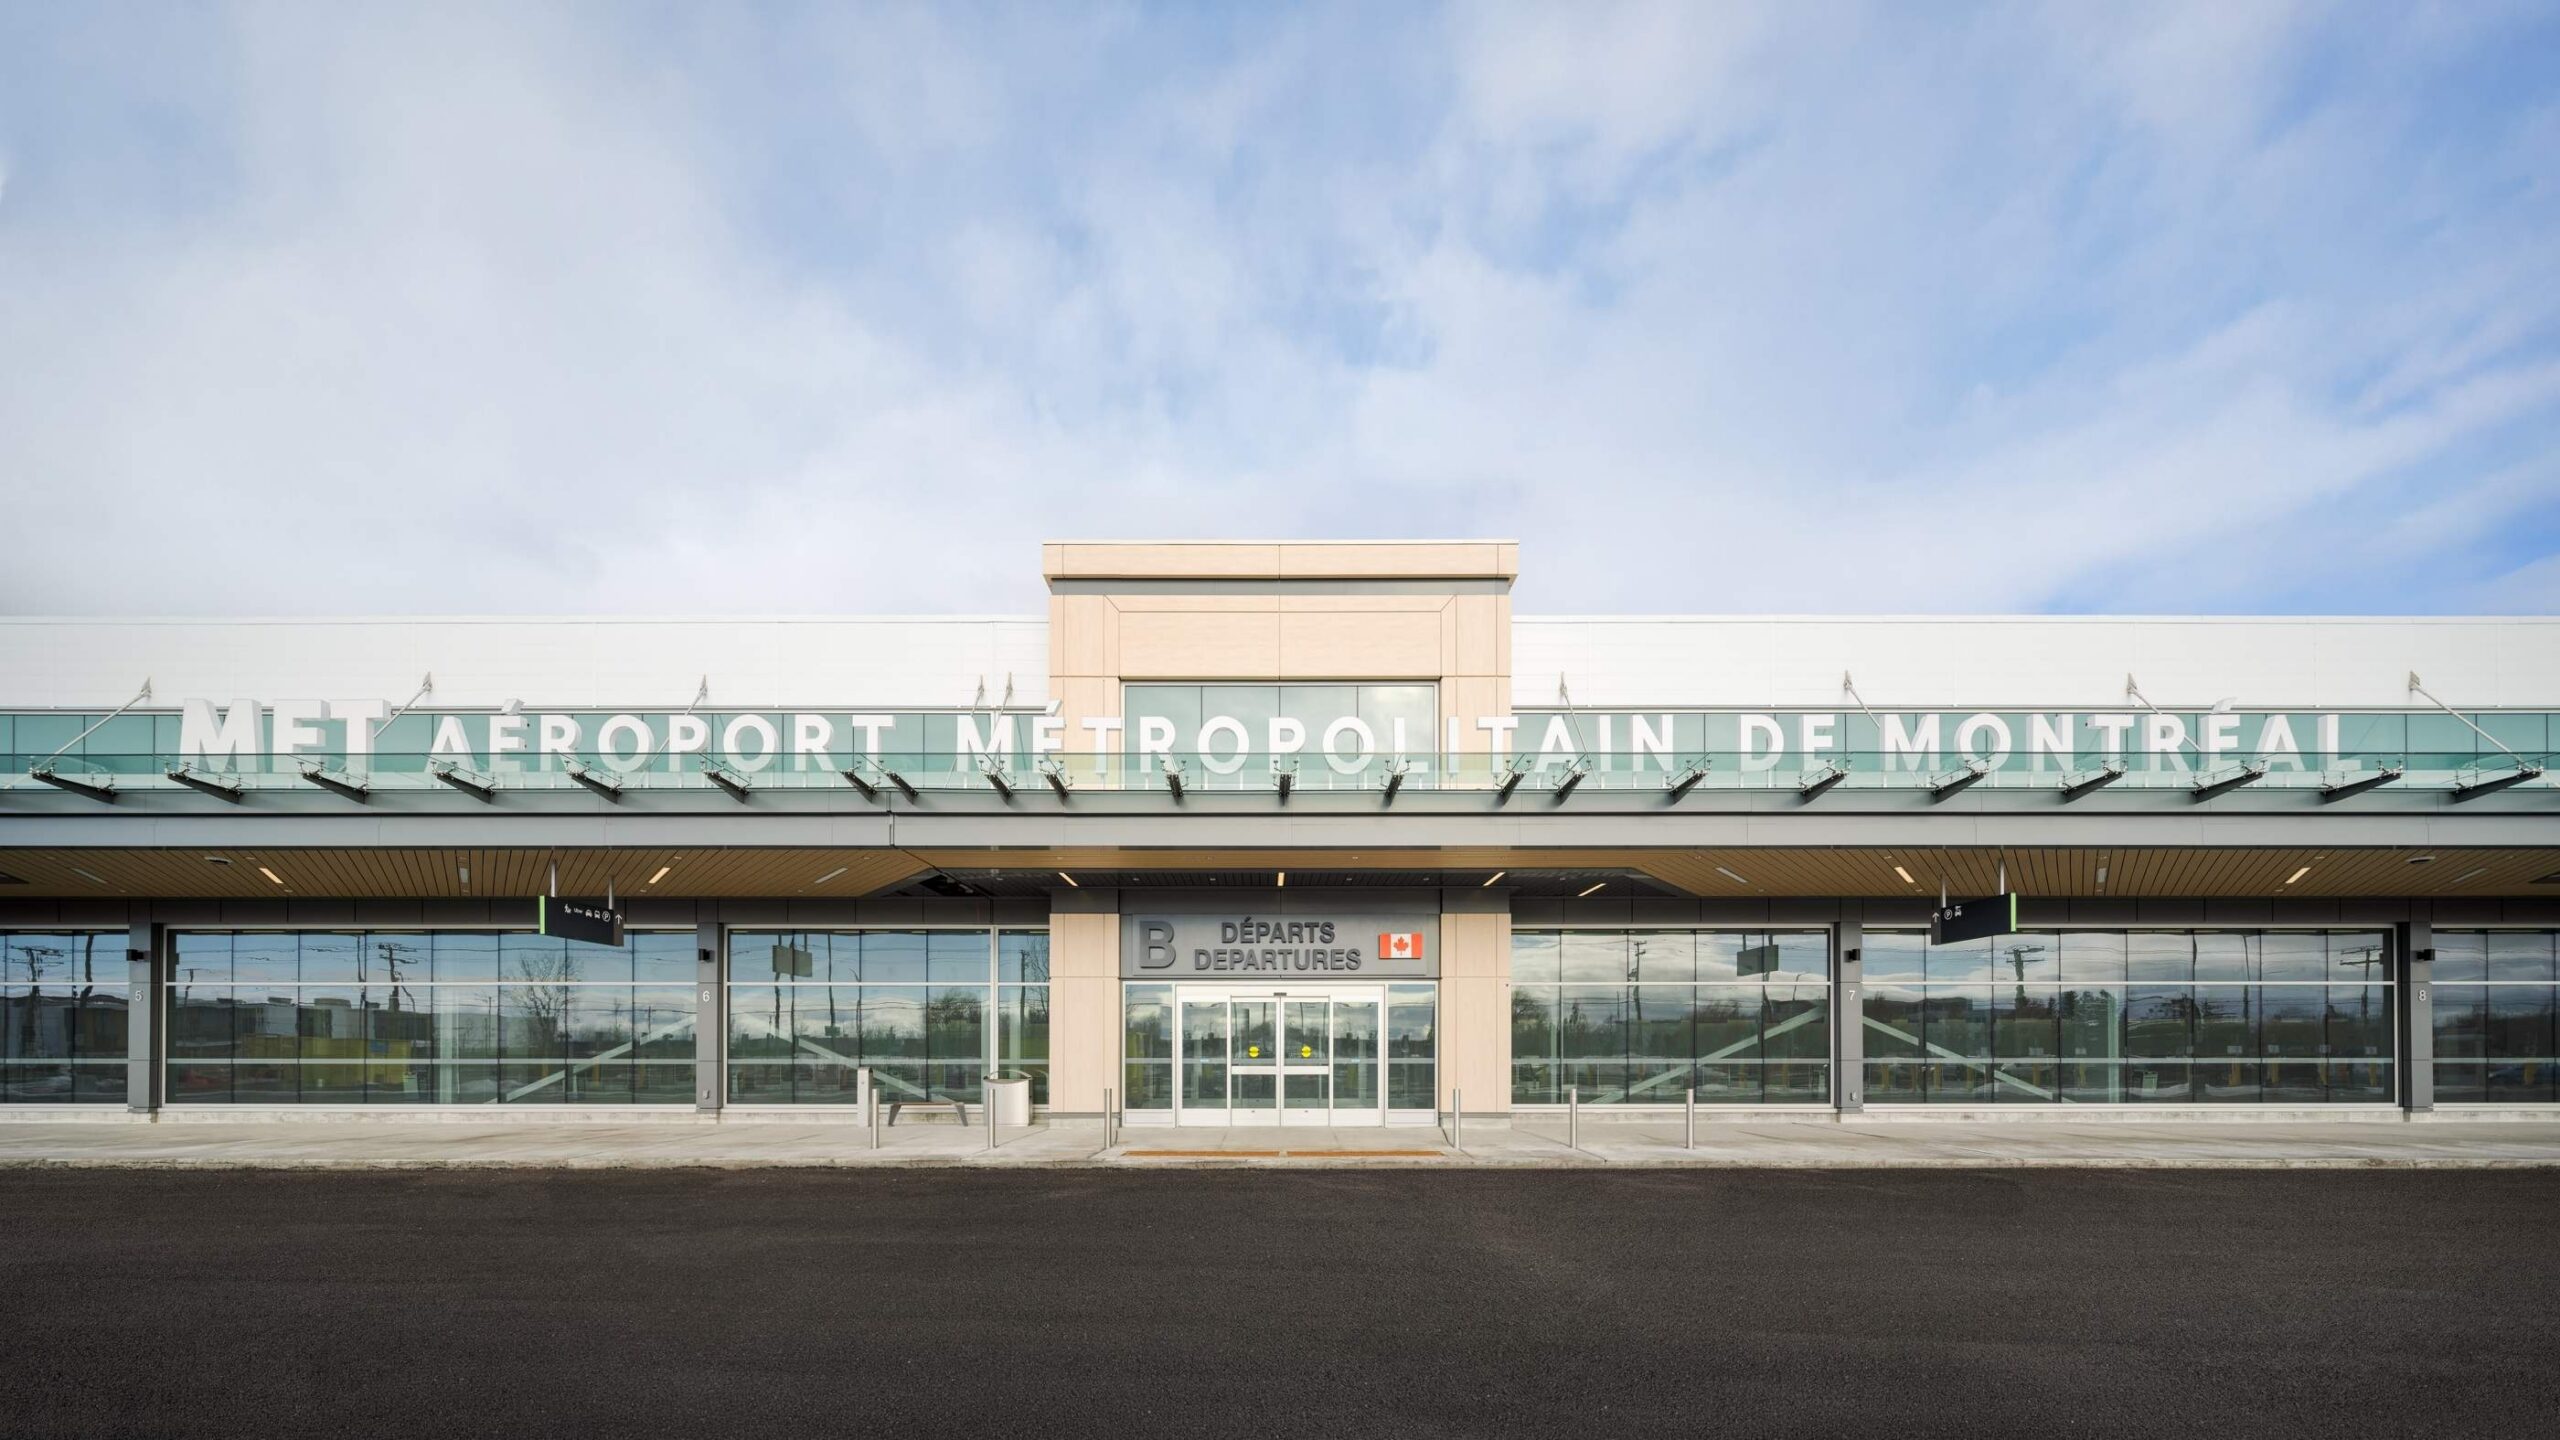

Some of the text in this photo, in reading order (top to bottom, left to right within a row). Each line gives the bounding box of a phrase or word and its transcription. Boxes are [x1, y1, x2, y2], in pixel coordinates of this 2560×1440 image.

[178, 697, 2361, 774] MET AÉROPORT MÉTROPOLITAIN DE MONTRÉAL
[1221, 917, 1335, 944] DÉPARTS
[1139, 920, 1177, 968] B
[1194, 949, 1361, 970] DEPARTURES
[135, 990, 143, 1002] 5
[703, 990, 710, 1002] 6
[1849, 990, 1855, 1000] 7
[2419, 990, 2426, 1001] 8
